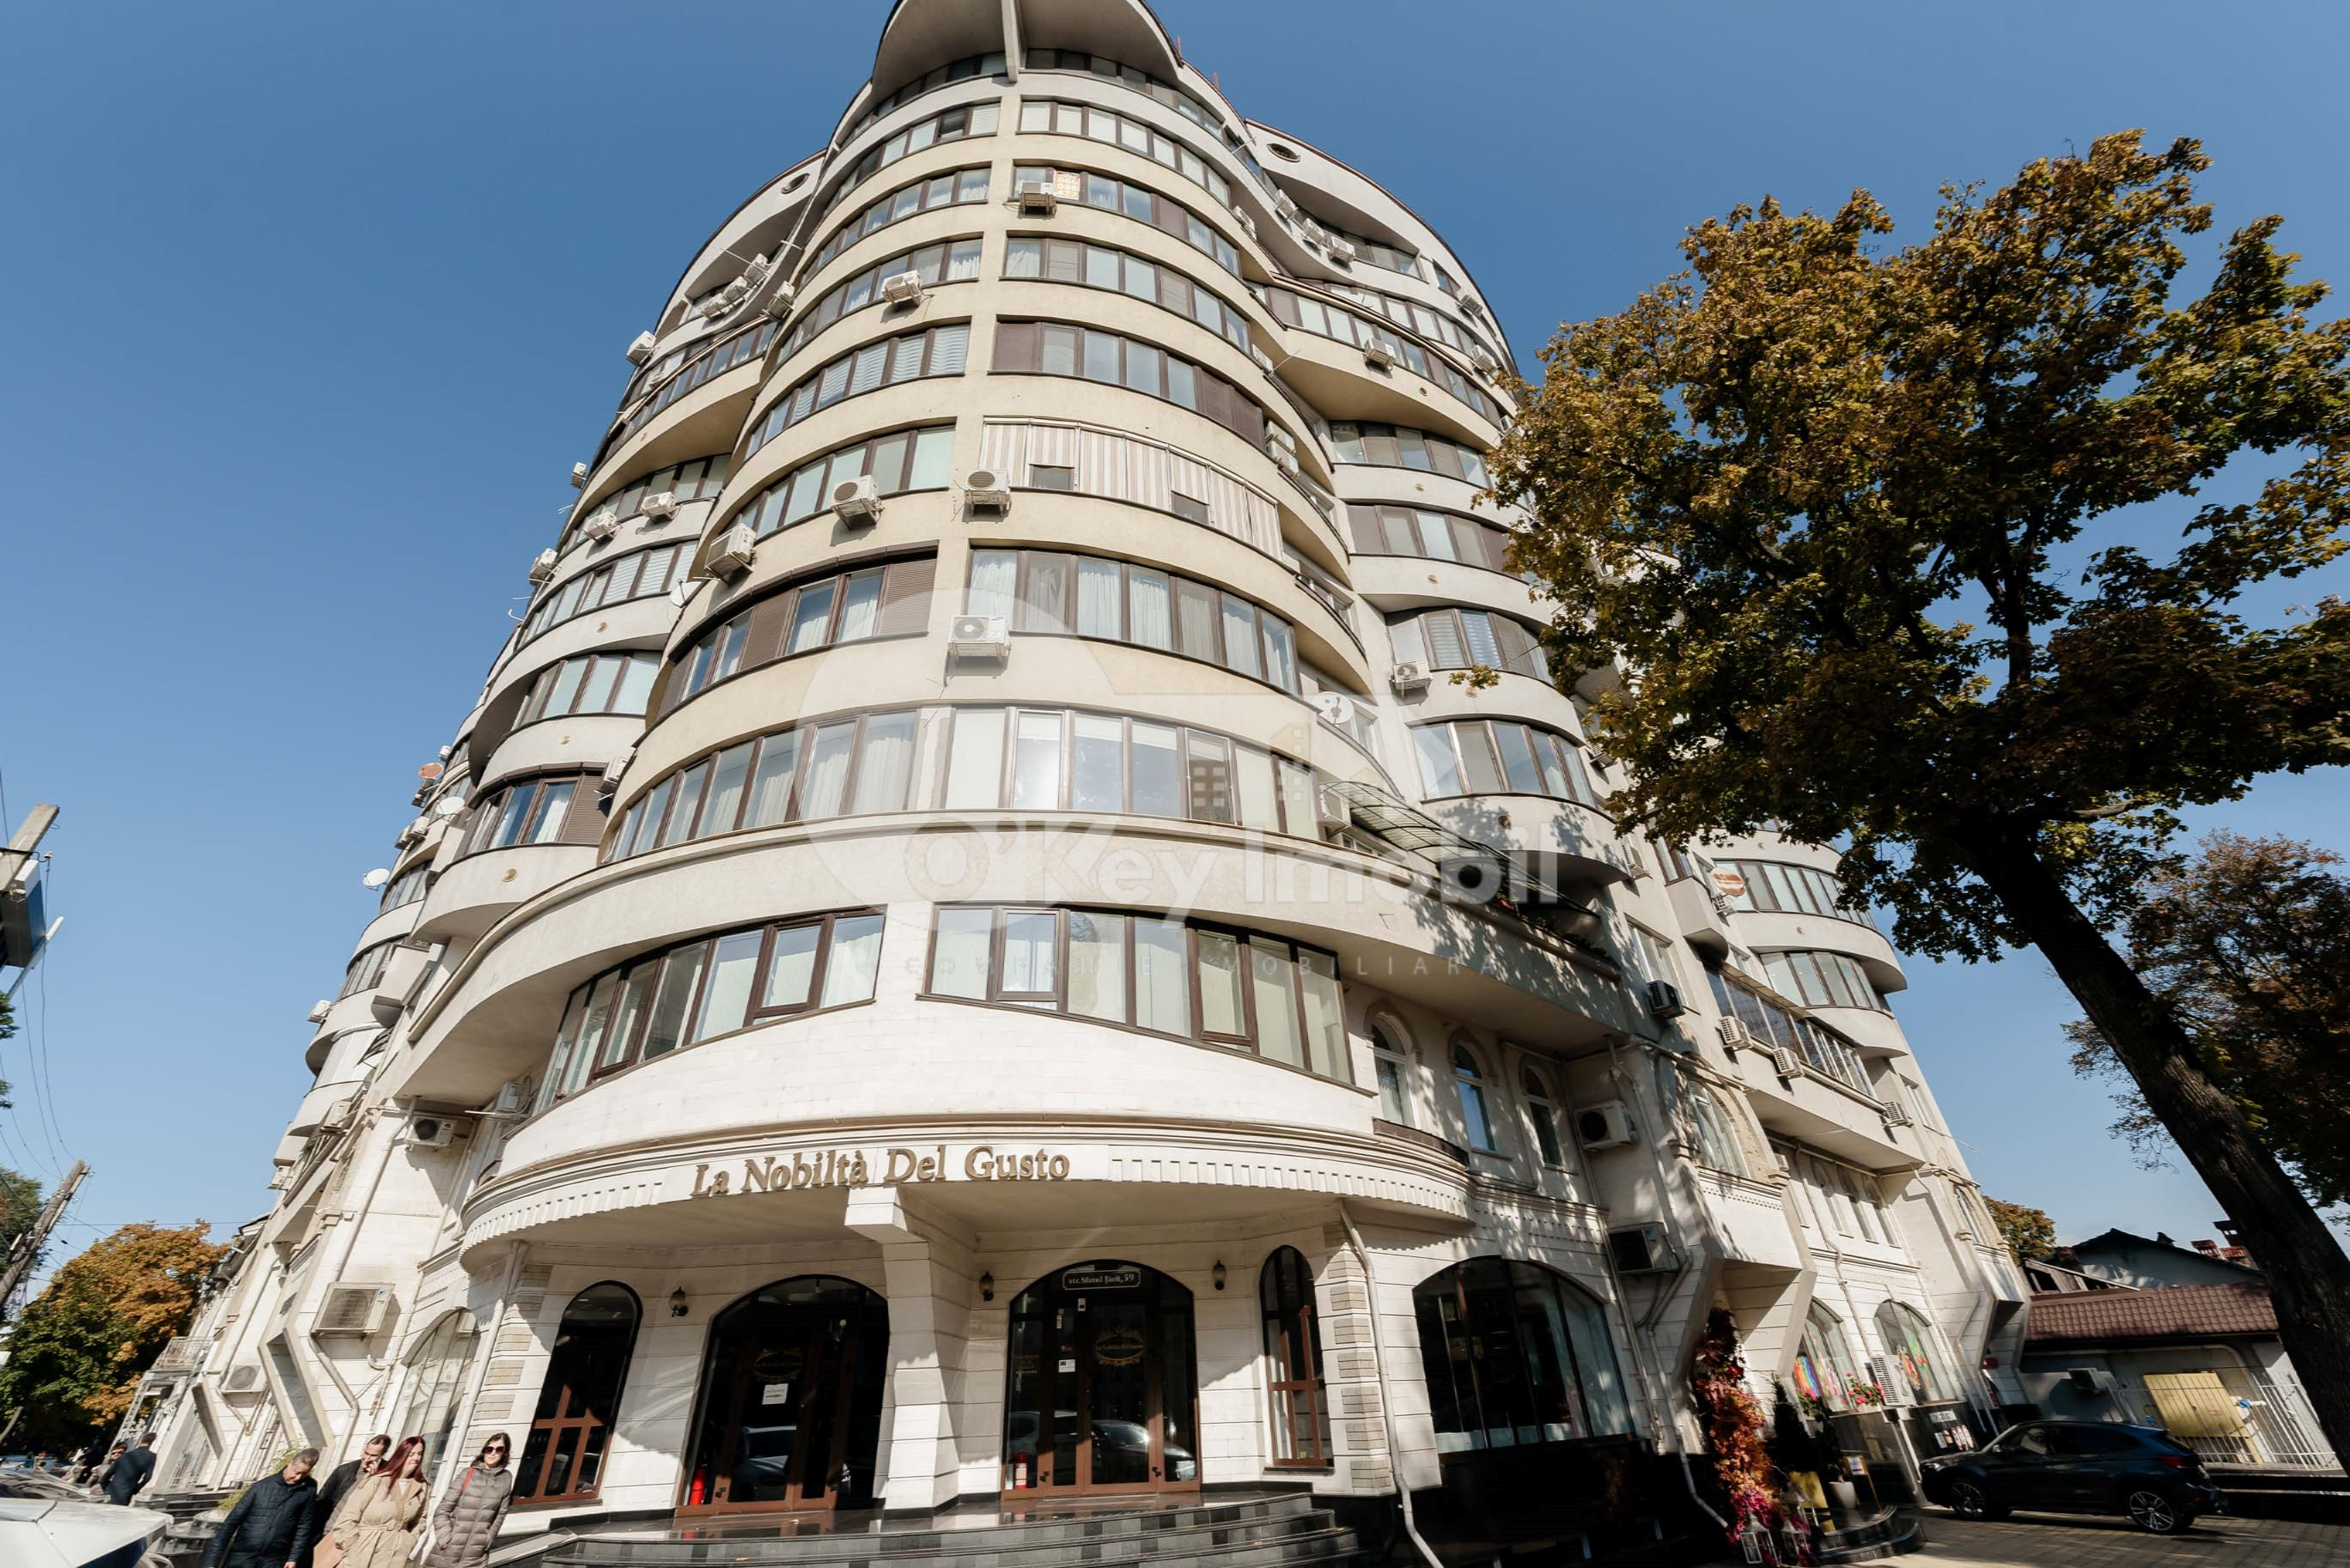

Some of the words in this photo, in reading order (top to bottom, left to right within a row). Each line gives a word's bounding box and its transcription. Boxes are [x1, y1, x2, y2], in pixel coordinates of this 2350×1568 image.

[690, 1164, 730, 1198] La
[740, 1150, 868, 1191] Nobiltà
[883, 1145, 947, 1183] Del
[965, 1146, 1070, 1182] Gusto
